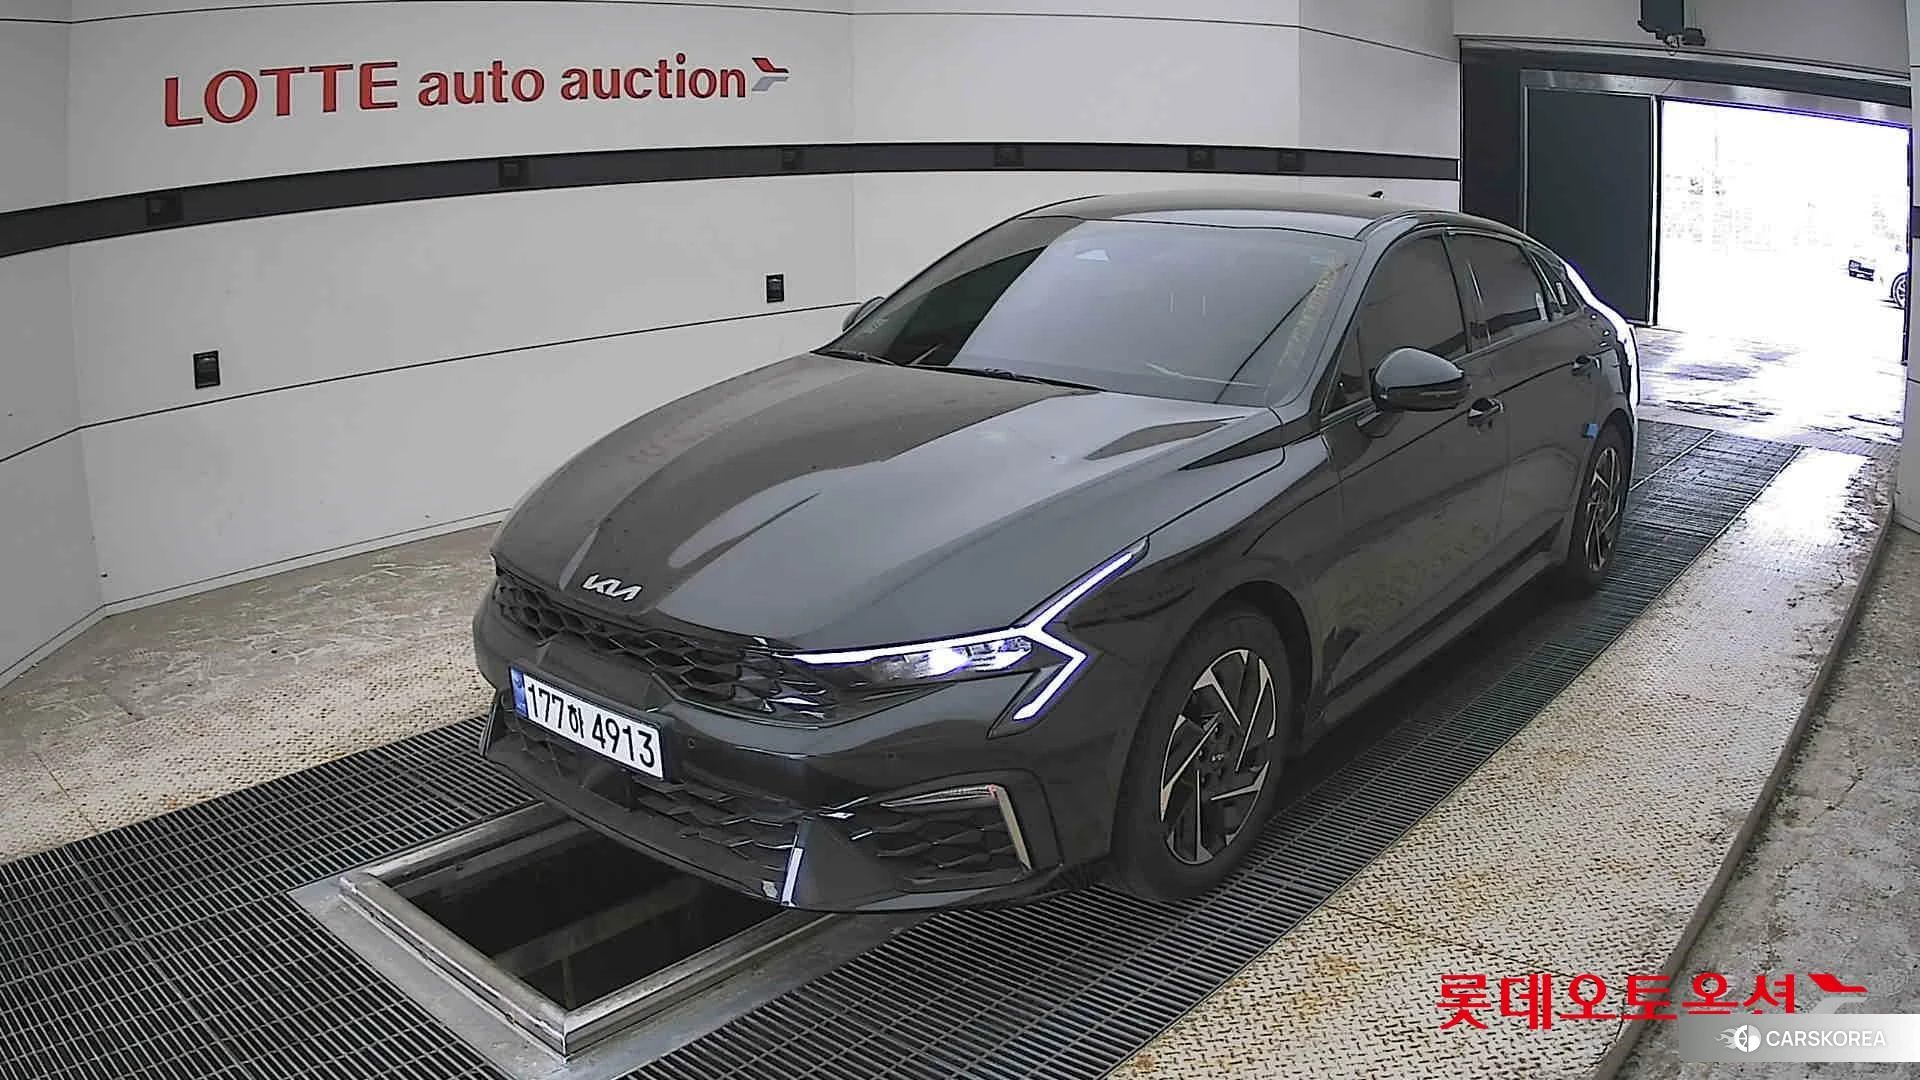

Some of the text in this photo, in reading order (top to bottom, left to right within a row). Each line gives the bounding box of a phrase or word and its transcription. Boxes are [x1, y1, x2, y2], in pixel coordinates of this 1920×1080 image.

[163, 53, 747, 128] LOTTE auto auction
[528, 684, 655, 768] 177하 4913
